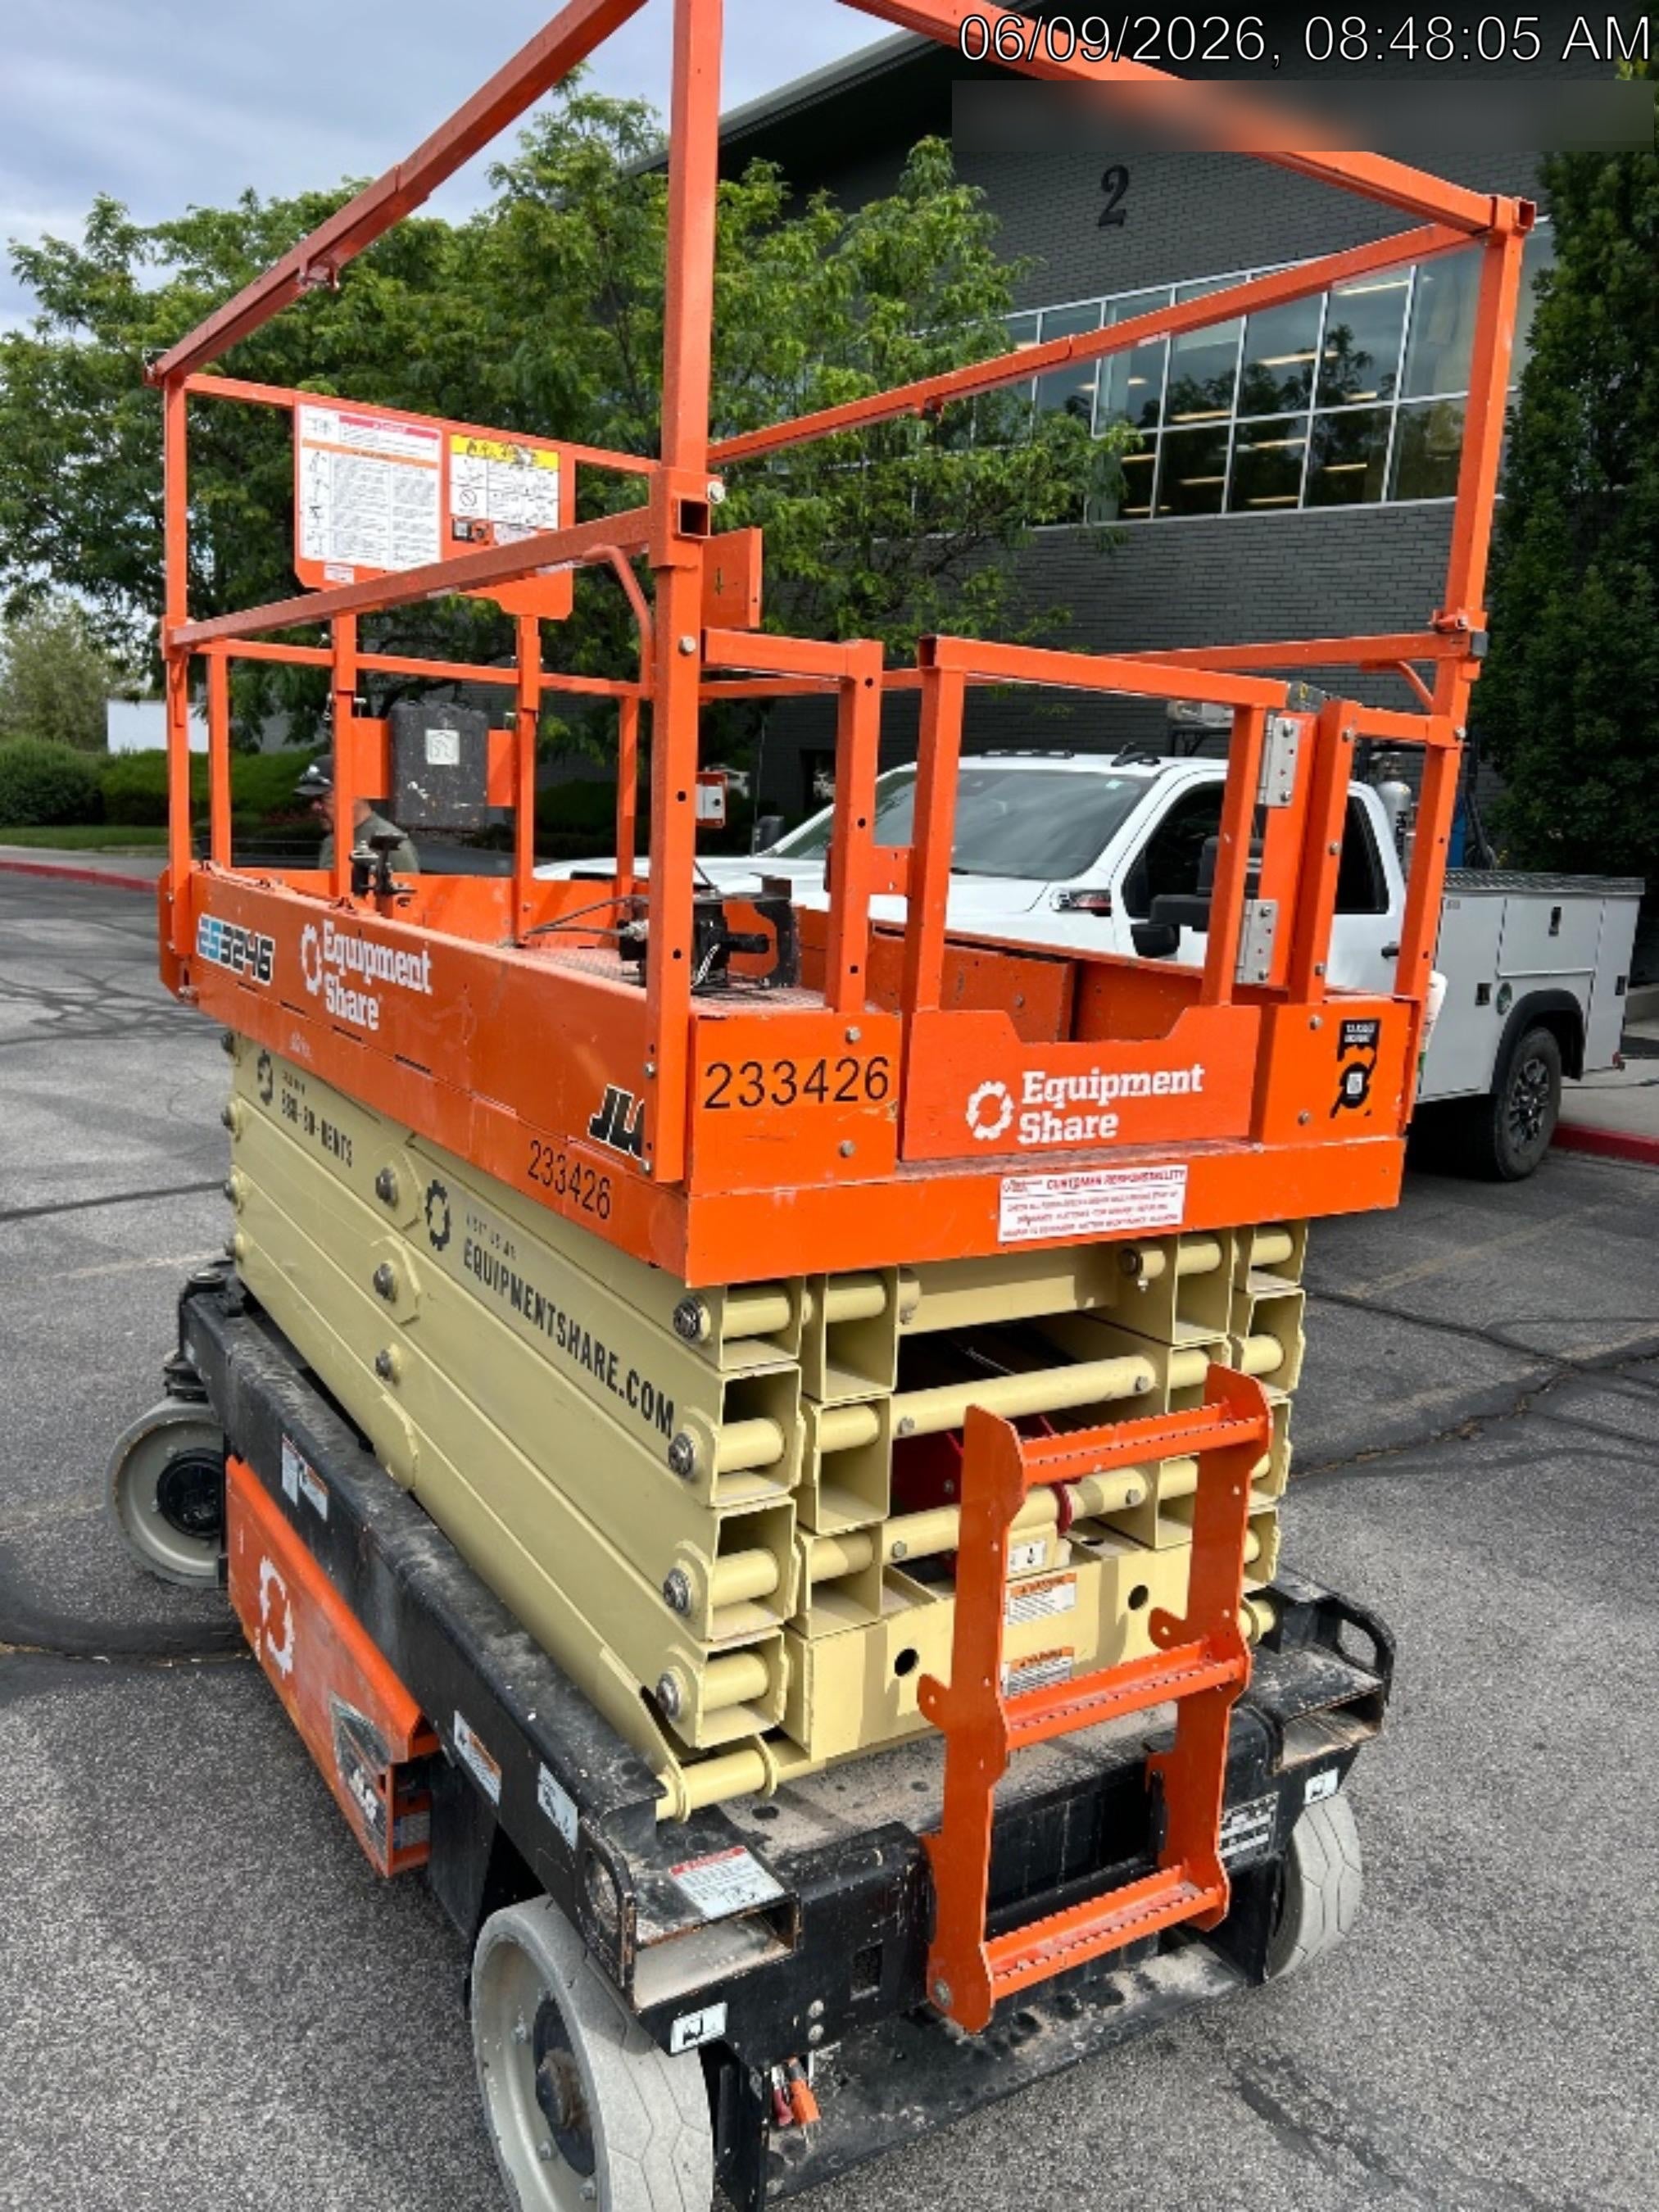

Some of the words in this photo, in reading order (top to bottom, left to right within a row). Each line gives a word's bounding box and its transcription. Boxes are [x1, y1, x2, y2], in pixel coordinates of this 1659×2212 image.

[1099, 165, 1129, 228] 2
[323, 918, 433, 995] Equipment
[324, 972, 379, 1031] Share
[703, 1056, 891, 1108] 233426
[1021, 1063, 1205, 1109] Equipment
[1017, 1110, 1119, 1145] Share
[527, 1139, 611, 1220] 233426
[463, 1235, 675, 1439] EQUIPMENTSHARE.COM
